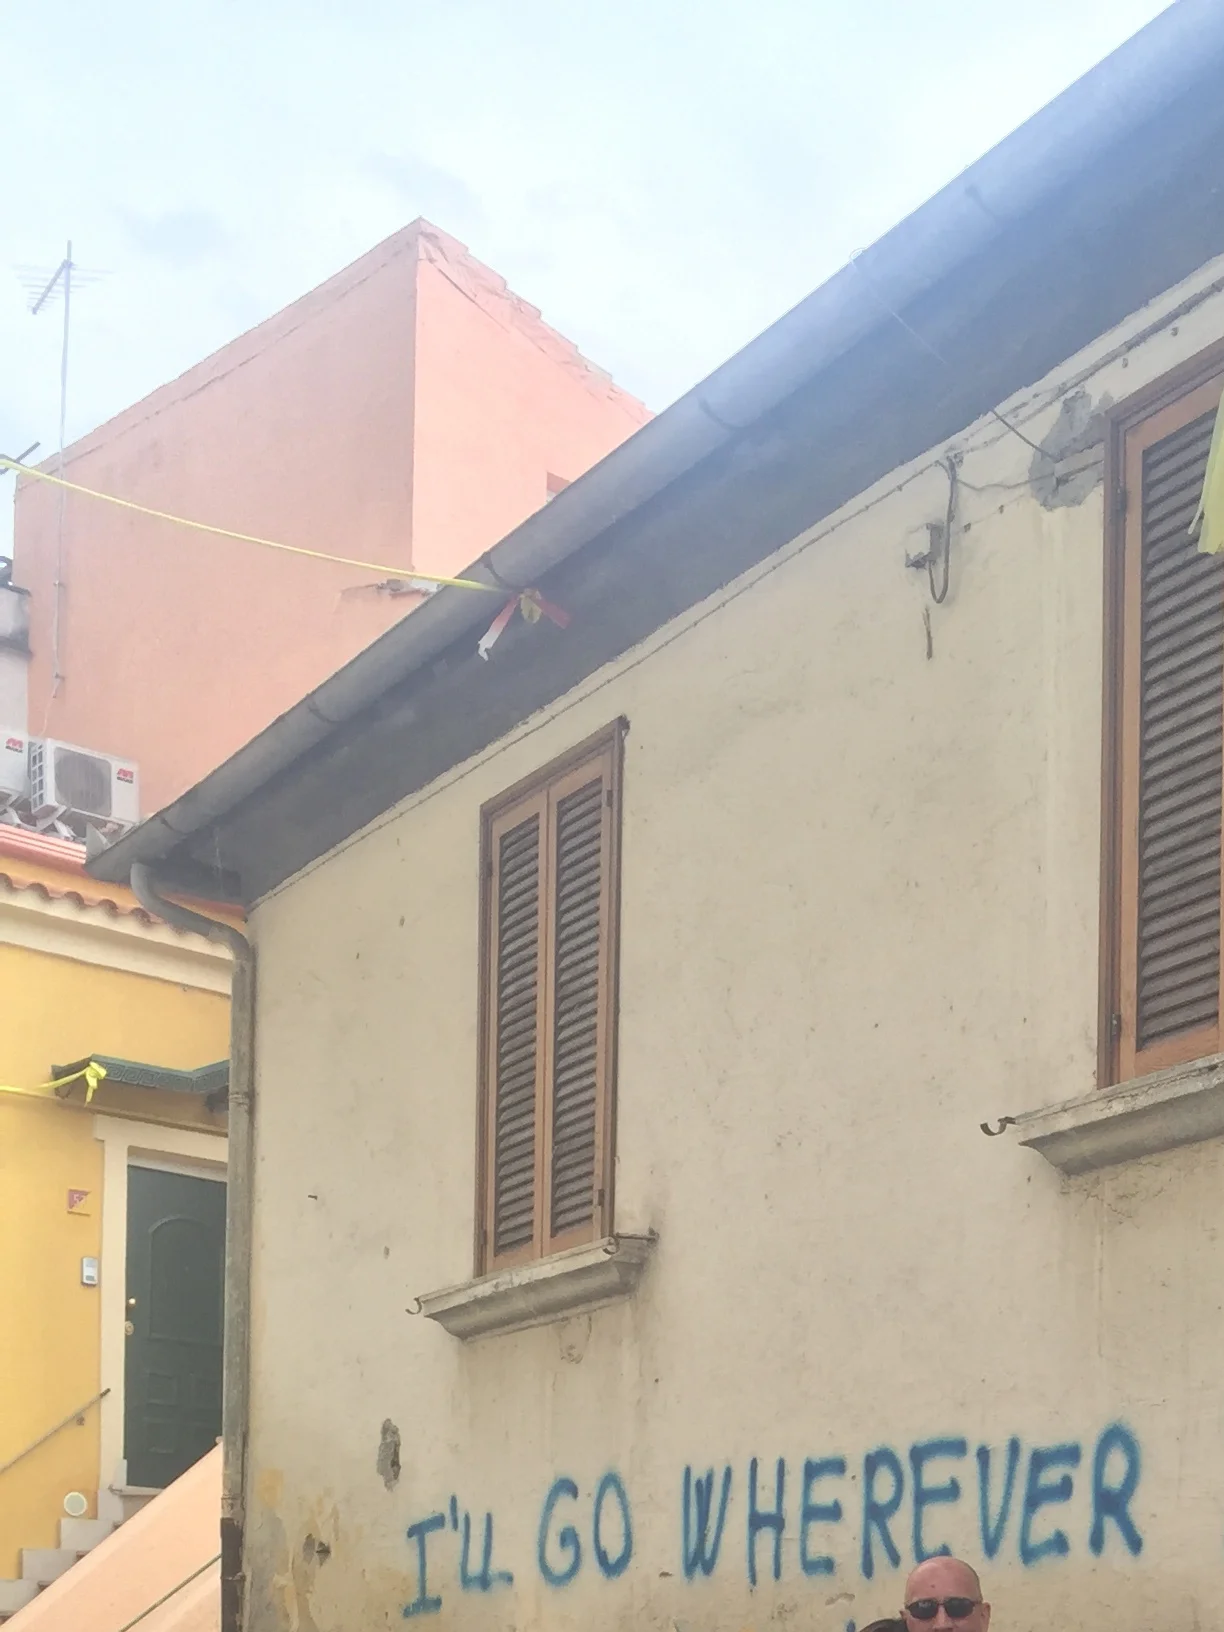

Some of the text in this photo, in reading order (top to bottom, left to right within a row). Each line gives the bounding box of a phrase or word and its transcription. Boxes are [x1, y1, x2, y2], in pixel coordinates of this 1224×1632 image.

[402, 1494, 514, 1618] I'LL
[537, 1471, 634, 1588] GO
[682, 1423, 1144, 1587] WHEREVER
